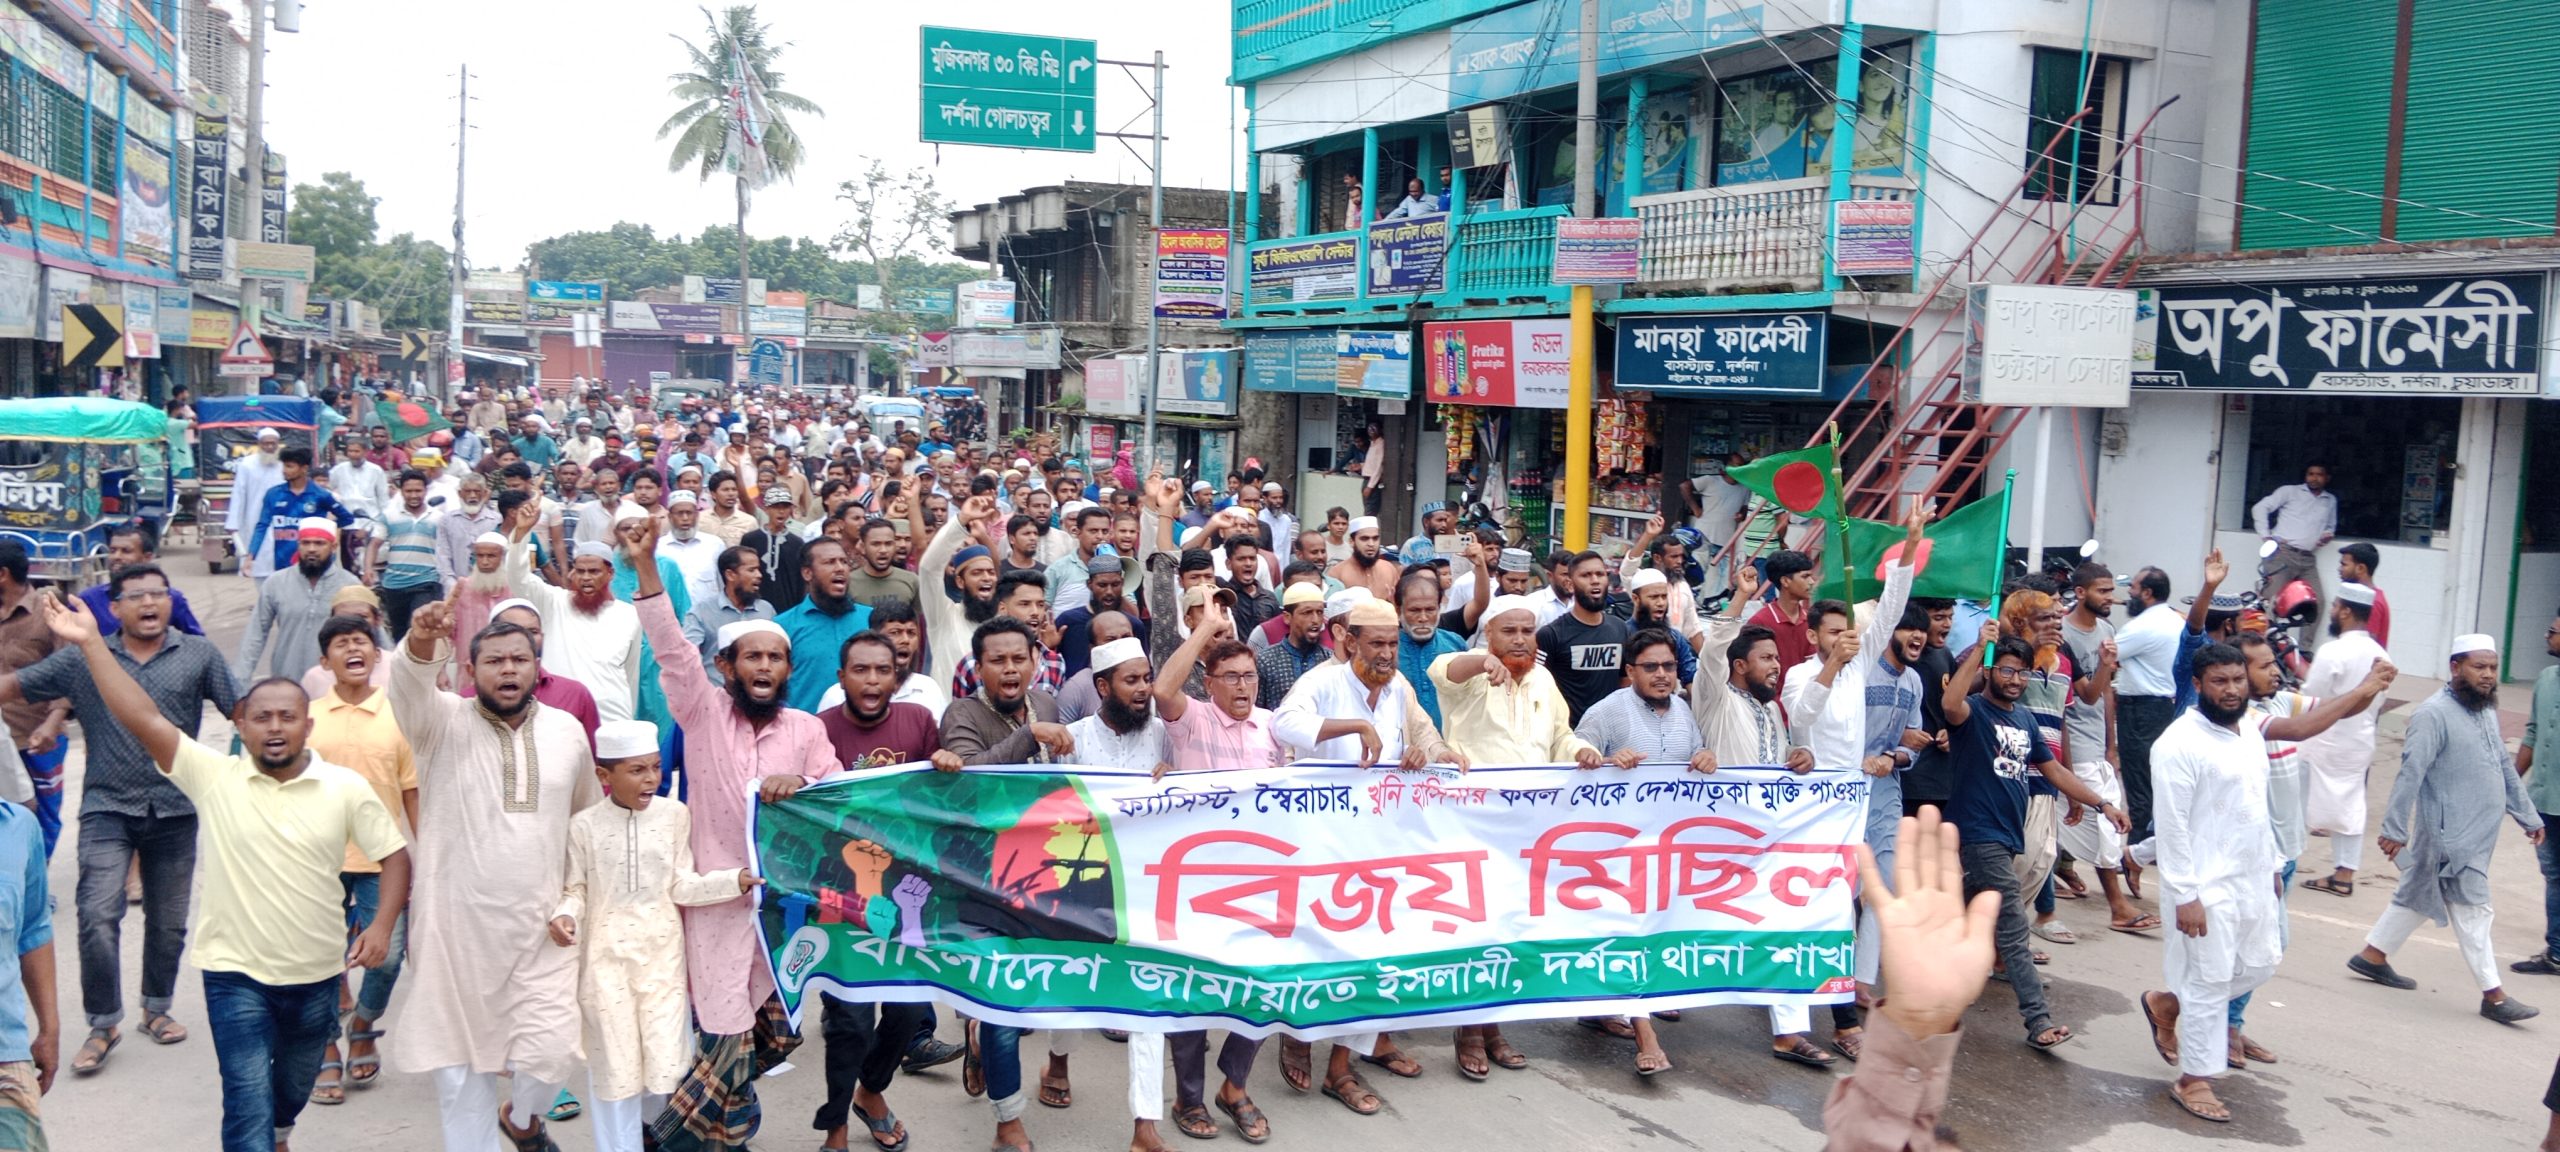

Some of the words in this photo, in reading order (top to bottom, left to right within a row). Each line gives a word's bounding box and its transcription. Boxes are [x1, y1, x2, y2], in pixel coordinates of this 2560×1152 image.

[930, 40, 991, 75] মুজিবনগর
[993, 56, 1014, 74] ৩০
[1017, 47, 1039, 77] কিঃ
[1041, 49, 1060, 79] মিঃ
[939, 98, 982, 129] দর্শনা
[985, 106, 1052, 139] গোলচত্বর
[1714, 315, 1812, 354] ফার্মেসী
[1994, 299, 2042, 338] অপু
[2049, 292, 2134, 335] ফার্মেসী
[2161, 287, 2297, 387] অপু
[2298, 279, 2534, 370] ফার্মেসী
[922, 344, 948, 353] VIGO
[1472, 344, 1505, 357] Frutika
[2401, 373, 2448, 389] দর্শনা,
[1580, 646, 1617, 668] NIKE
[1112, 783, 1241, 819] ফ্যাসিস্ট,
[1255, 782, 1359, 818] স্বৈরাচার,
[1367, 774, 1405, 817] খুনি
[1500, 787, 1564, 807] কবল
[1570, 781, 1630, 807] থেকে
[1636, 777, 1753, 813] দেশমাতৃকা
[1759, 776, 1800, 811] মুক্তি
[1144, 829, 1490, 941] বিজয়
[1519, 816, 1860, 926] মিছিল
[846, 930, 1112, 993] বাংলাদেশ
[1125, 960, 1367, 1015] জামায়াতে
[1376, 946, 1524, 1004] ইসলামী,
[1540, 938, 1652, 984] দর্শনা
[1661, 940, 1754, 979] থানা
[1764, 940, 1856, 979] শাখা
